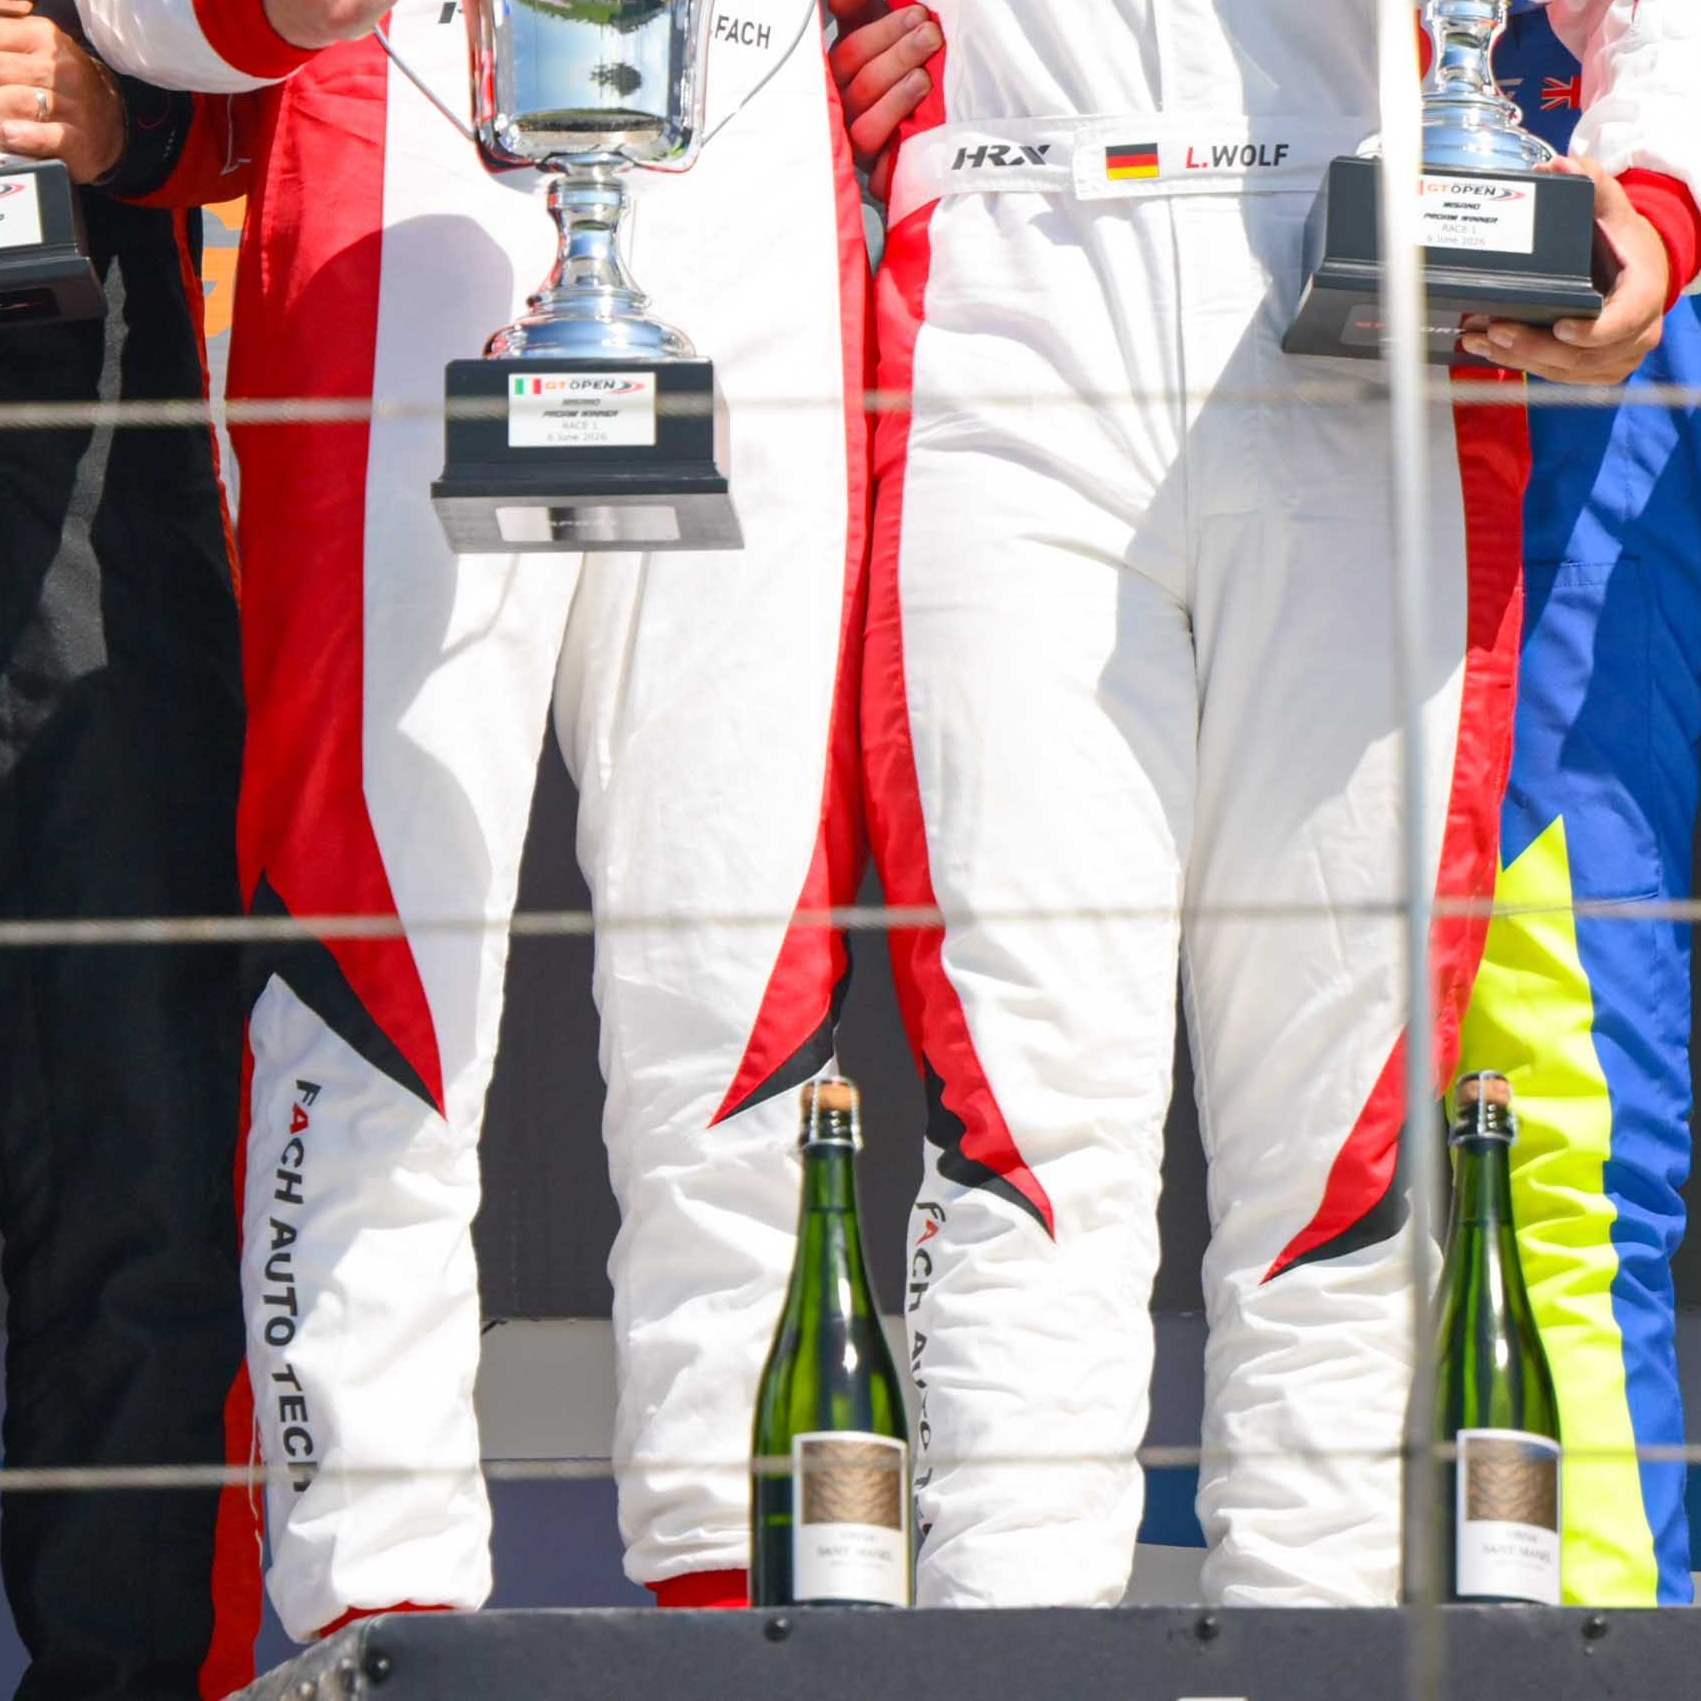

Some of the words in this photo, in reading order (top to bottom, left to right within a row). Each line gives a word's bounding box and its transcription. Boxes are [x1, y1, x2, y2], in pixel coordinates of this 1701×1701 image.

[952, 143, 1051, 171] HRX
[1442, 201, 1481, 210] MISANO
[275, 1078, 323, 1206] FACH
[260, 1215, 300, 1349] AUTO
[908, 1200, 947, 1316] FACH
